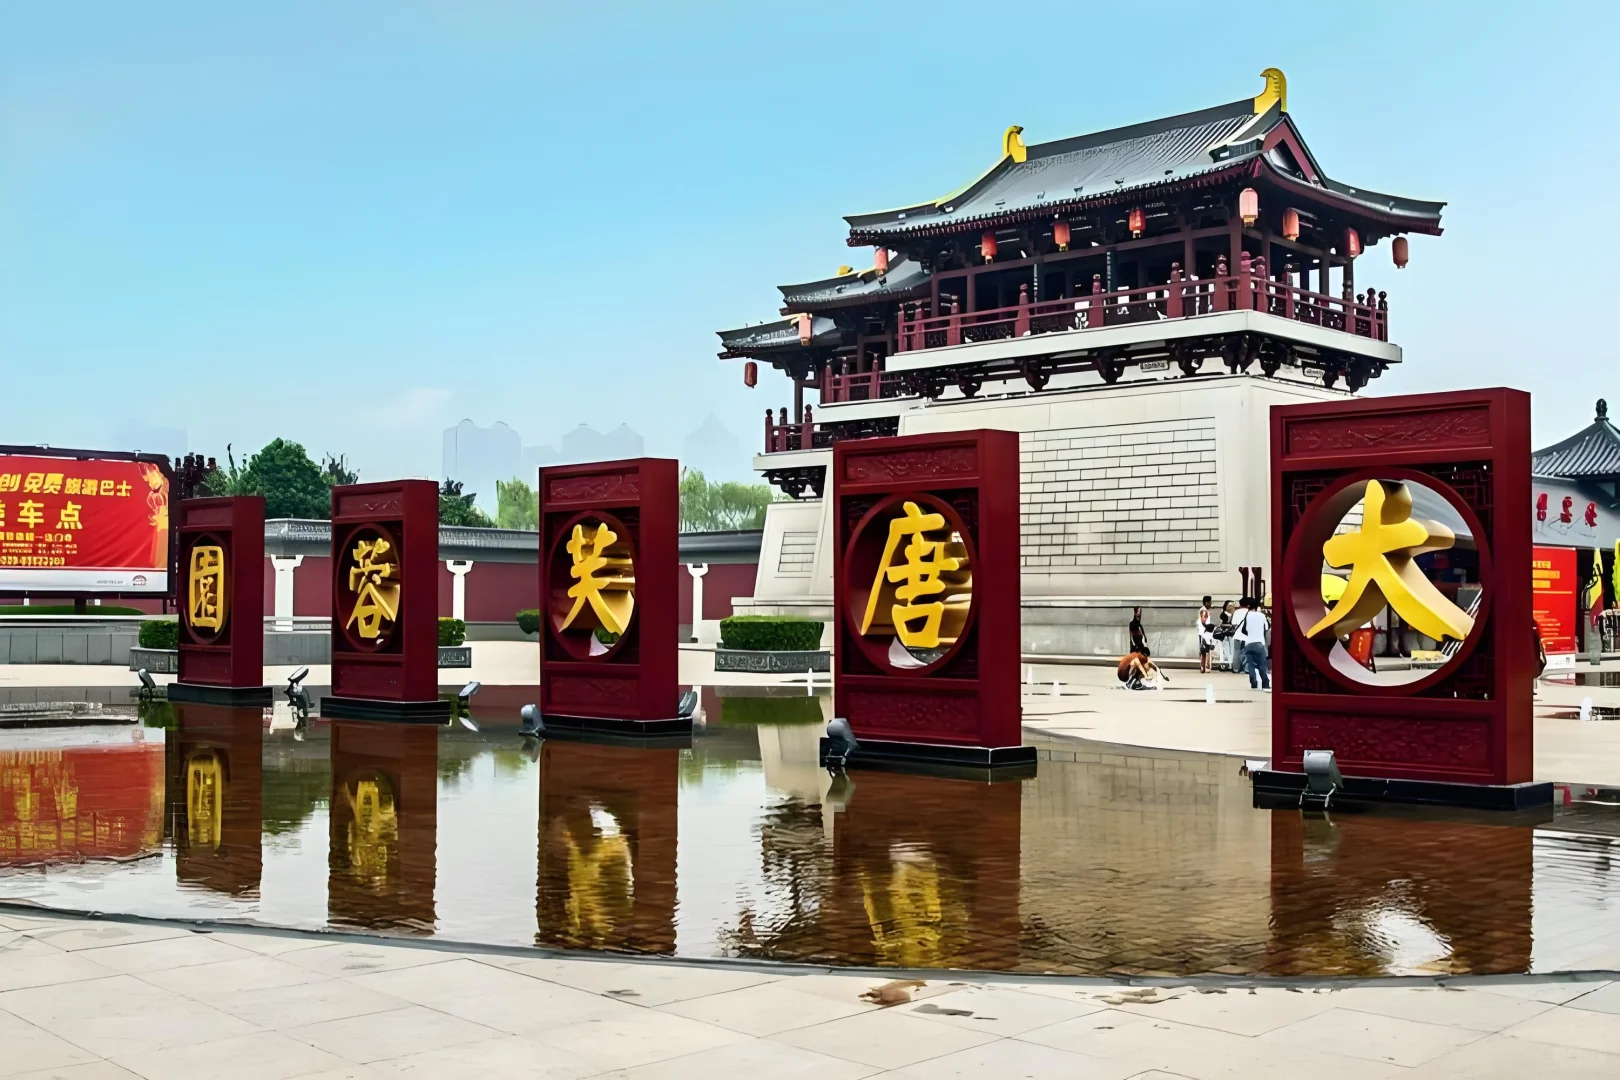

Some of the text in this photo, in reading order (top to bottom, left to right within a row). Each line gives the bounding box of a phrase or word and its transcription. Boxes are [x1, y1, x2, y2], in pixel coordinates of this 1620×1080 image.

[0, 499, 83, 529] 车点
[1305, 479, 1467, 642] 大
[346, 537, 398, 639] 蓉
[559, 522, 627, 635] 芙
[861, 501, 957, 649] 唐
